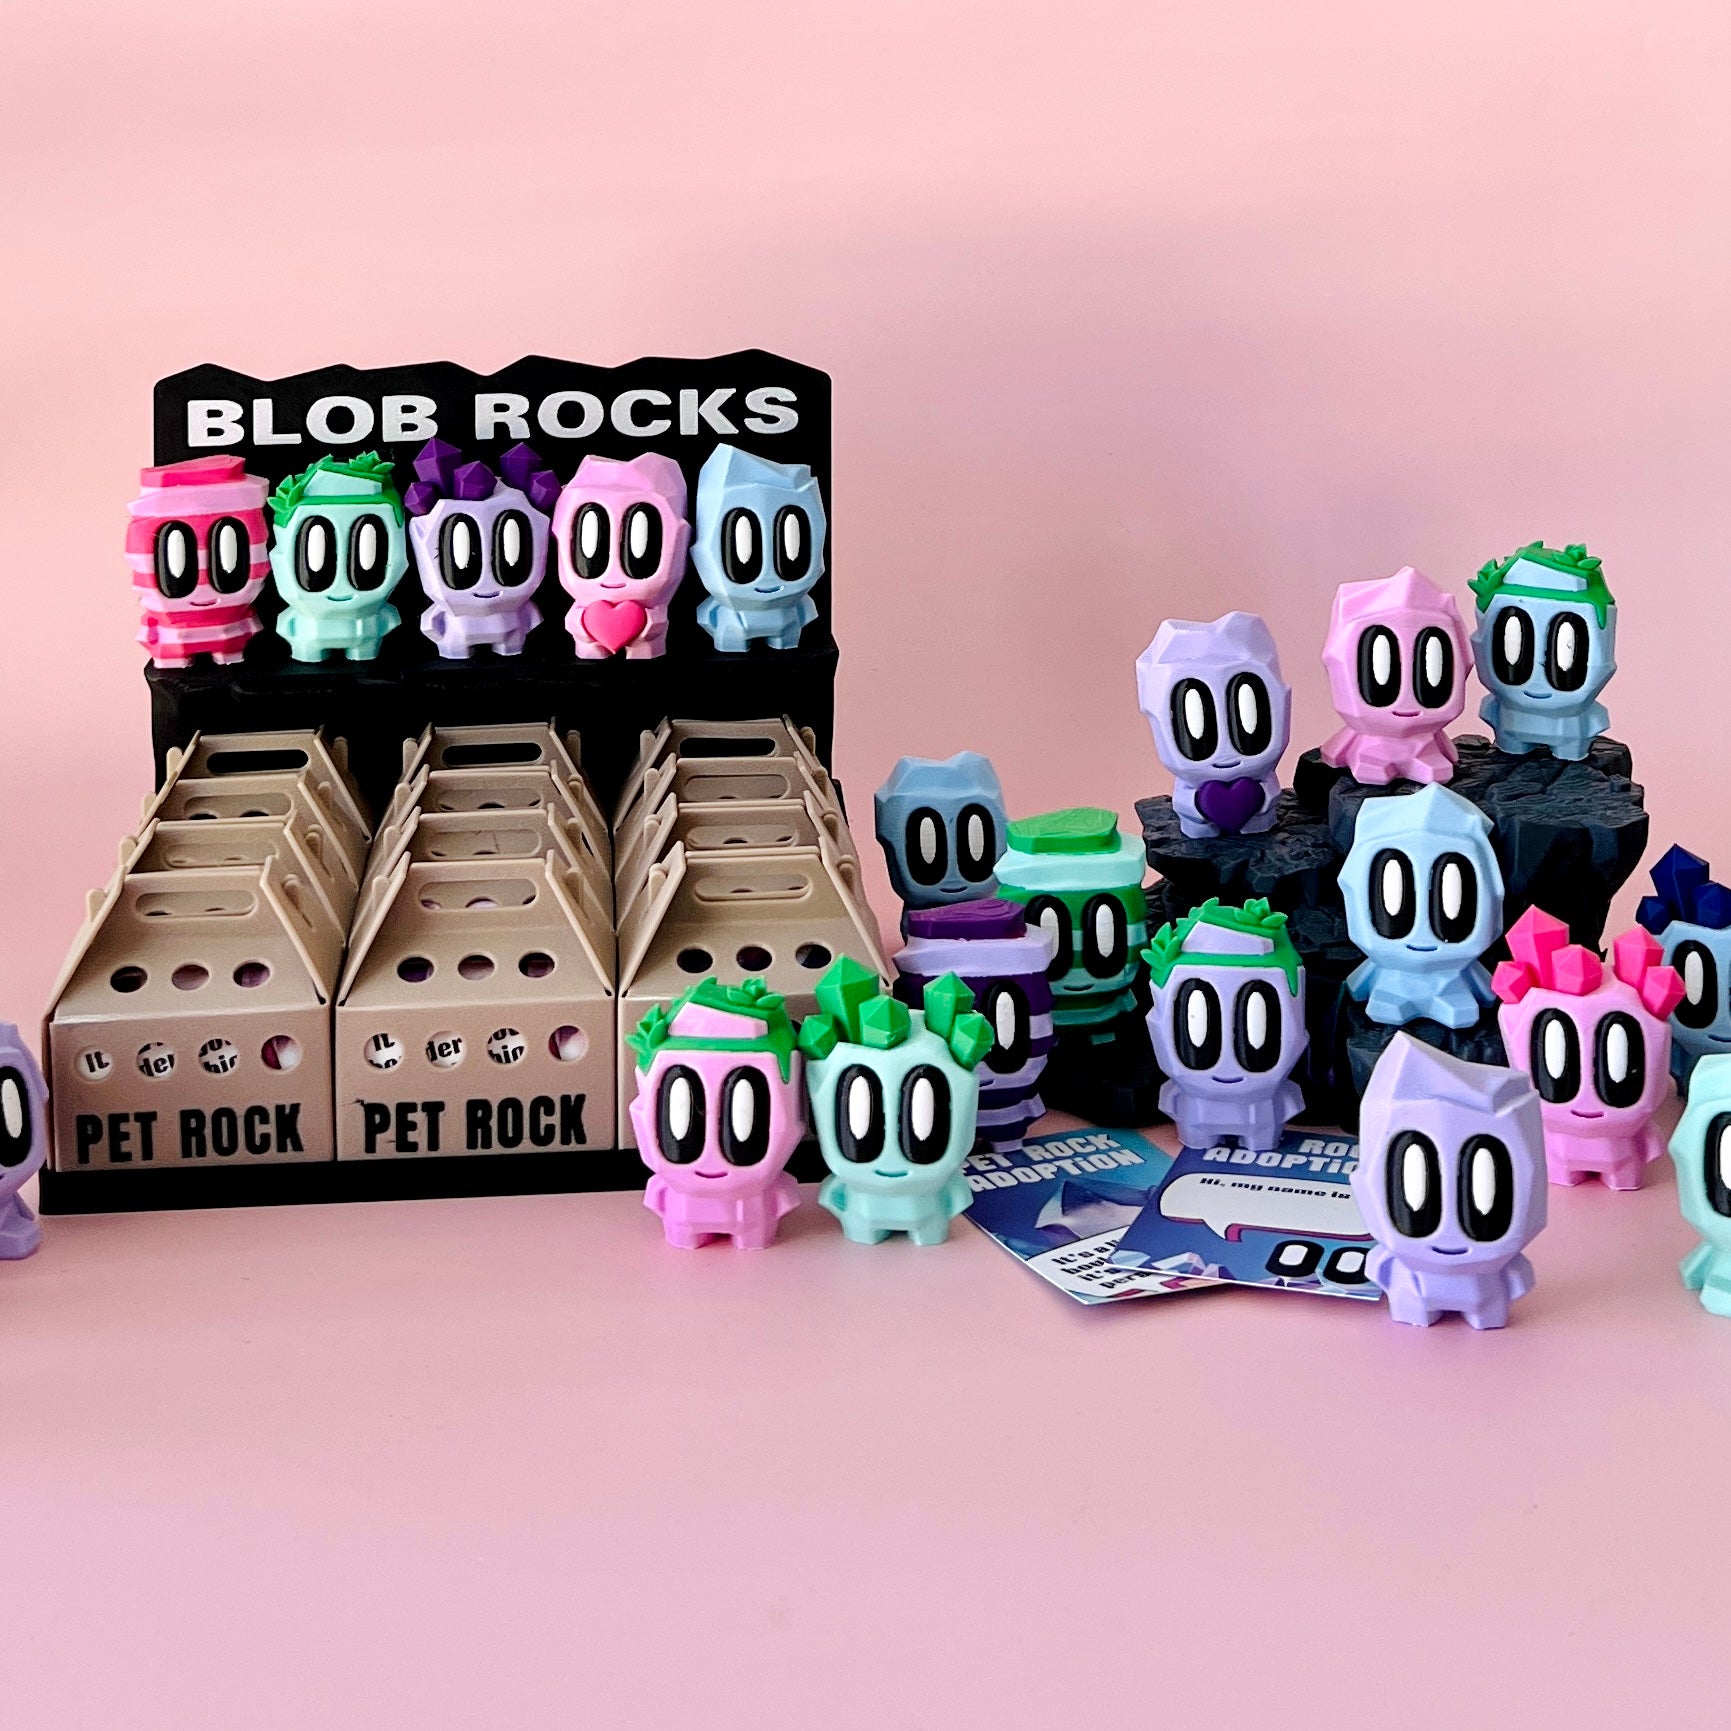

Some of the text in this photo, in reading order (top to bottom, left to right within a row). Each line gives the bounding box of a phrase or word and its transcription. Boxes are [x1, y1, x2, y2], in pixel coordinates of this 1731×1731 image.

[187, 387, 799, 447] BLOB ROCKS
[76, 1103, 304, 1164] PET ROCK
[364, 1094, 587, 1153] PET ROCK
[1023, 1134, 1121, 1161] ROCK
[1231, 1182, 1263, 1191] my
[1267, 1186, 1327, 1197] name
[1331, 1191, 1351, 1199] is
